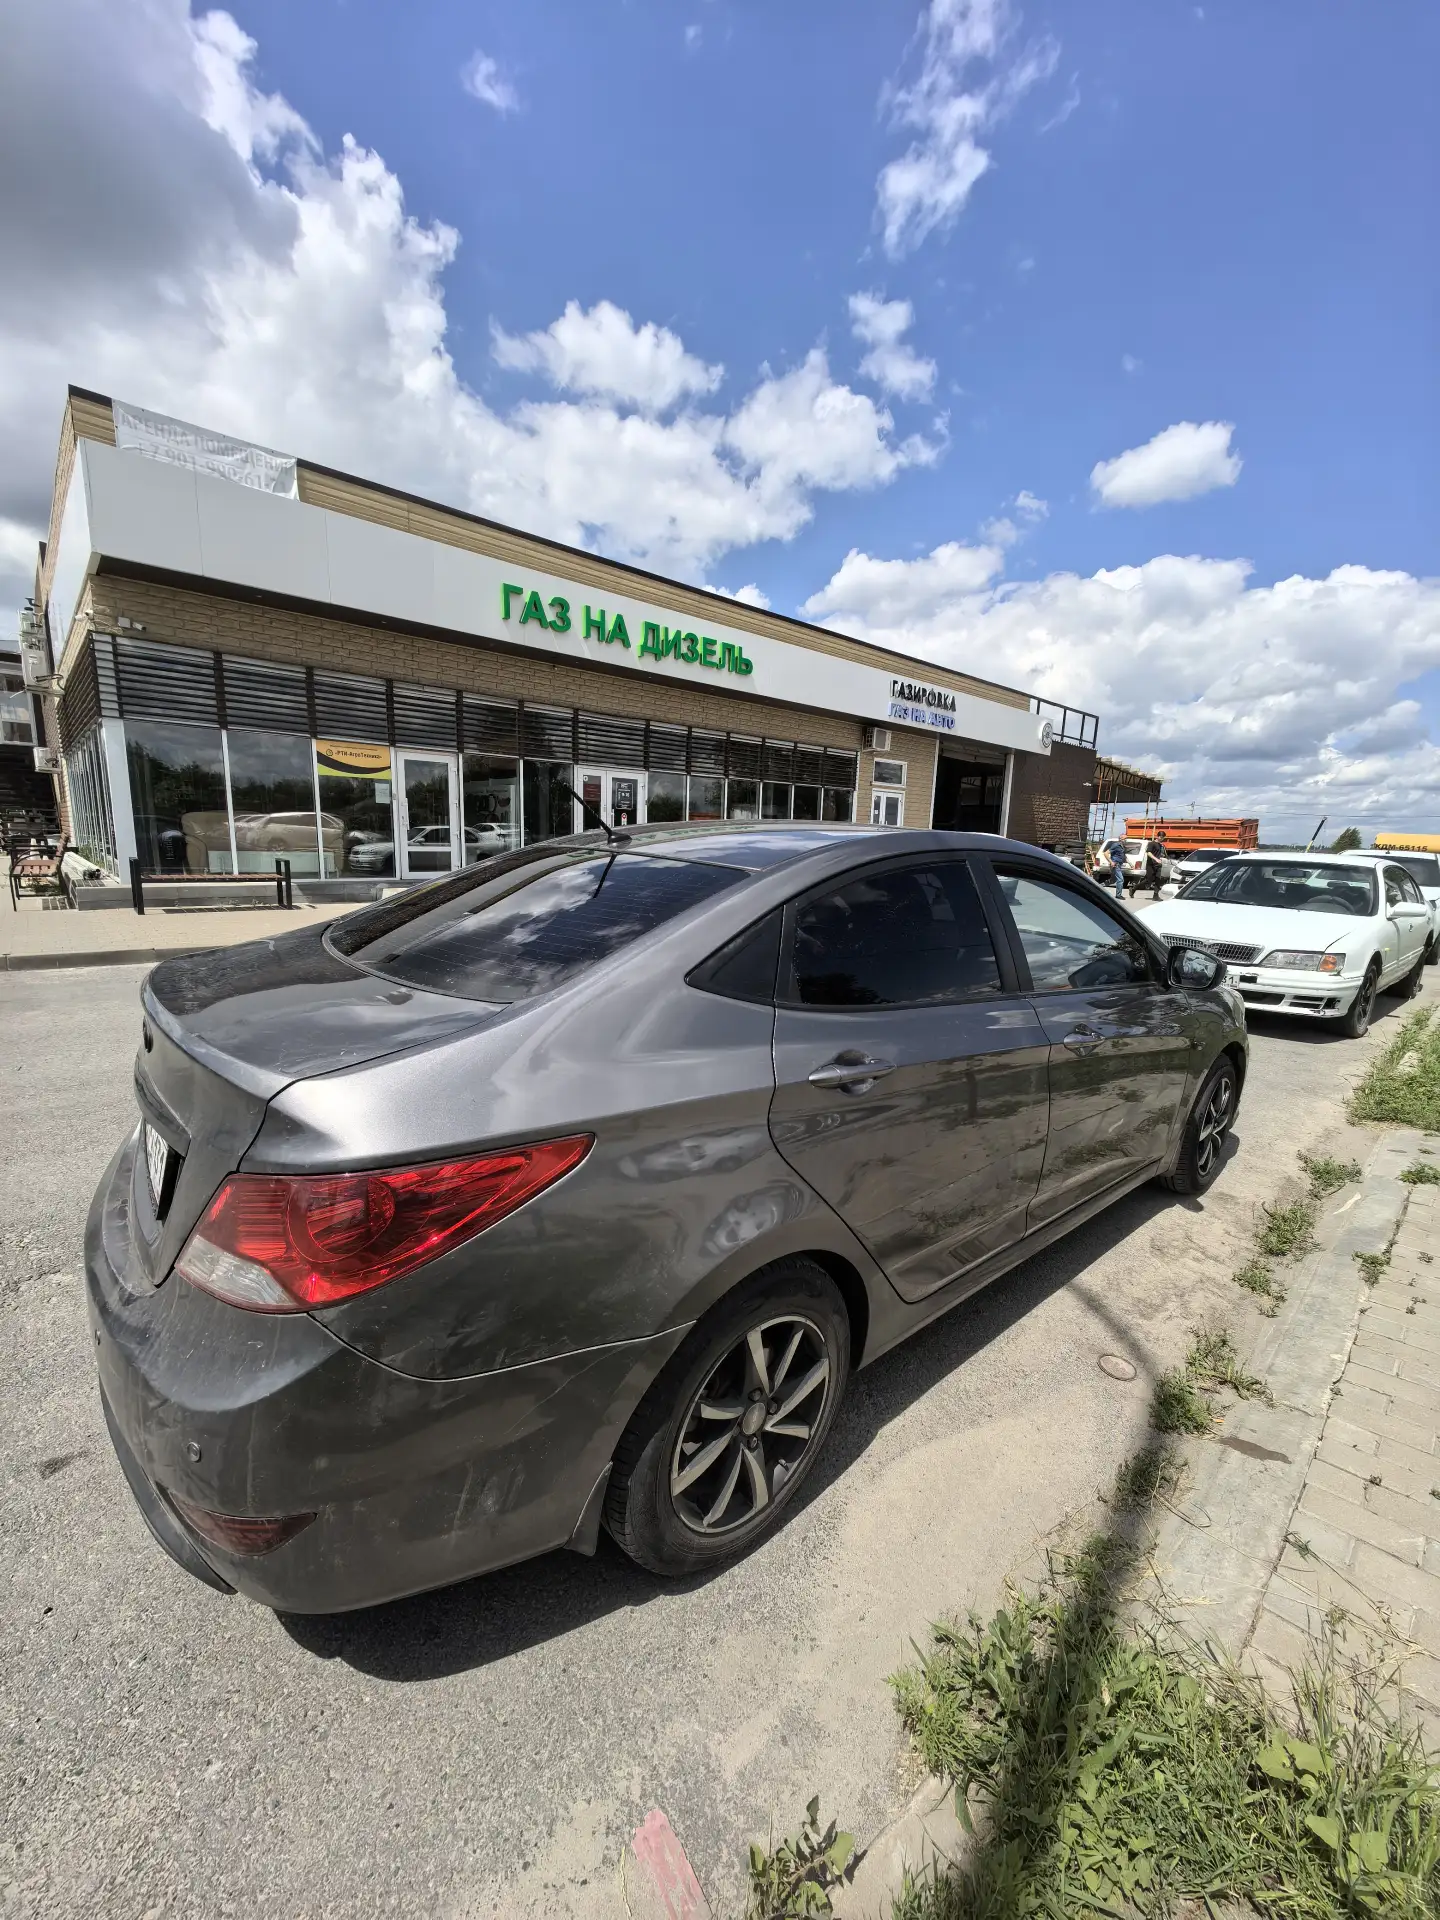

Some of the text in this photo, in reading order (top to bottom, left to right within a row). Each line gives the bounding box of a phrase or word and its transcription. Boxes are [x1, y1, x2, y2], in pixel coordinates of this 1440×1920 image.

[121, 413, 192, 447] АРЕНДА
[502, 582, 754, 676] ГАЗ НА ДИЗЕЛЬ
[889, 679, 957, 712] ГАЗИРОВКА
[888, 702, 956, 730] ГАЗ НА АВТО
